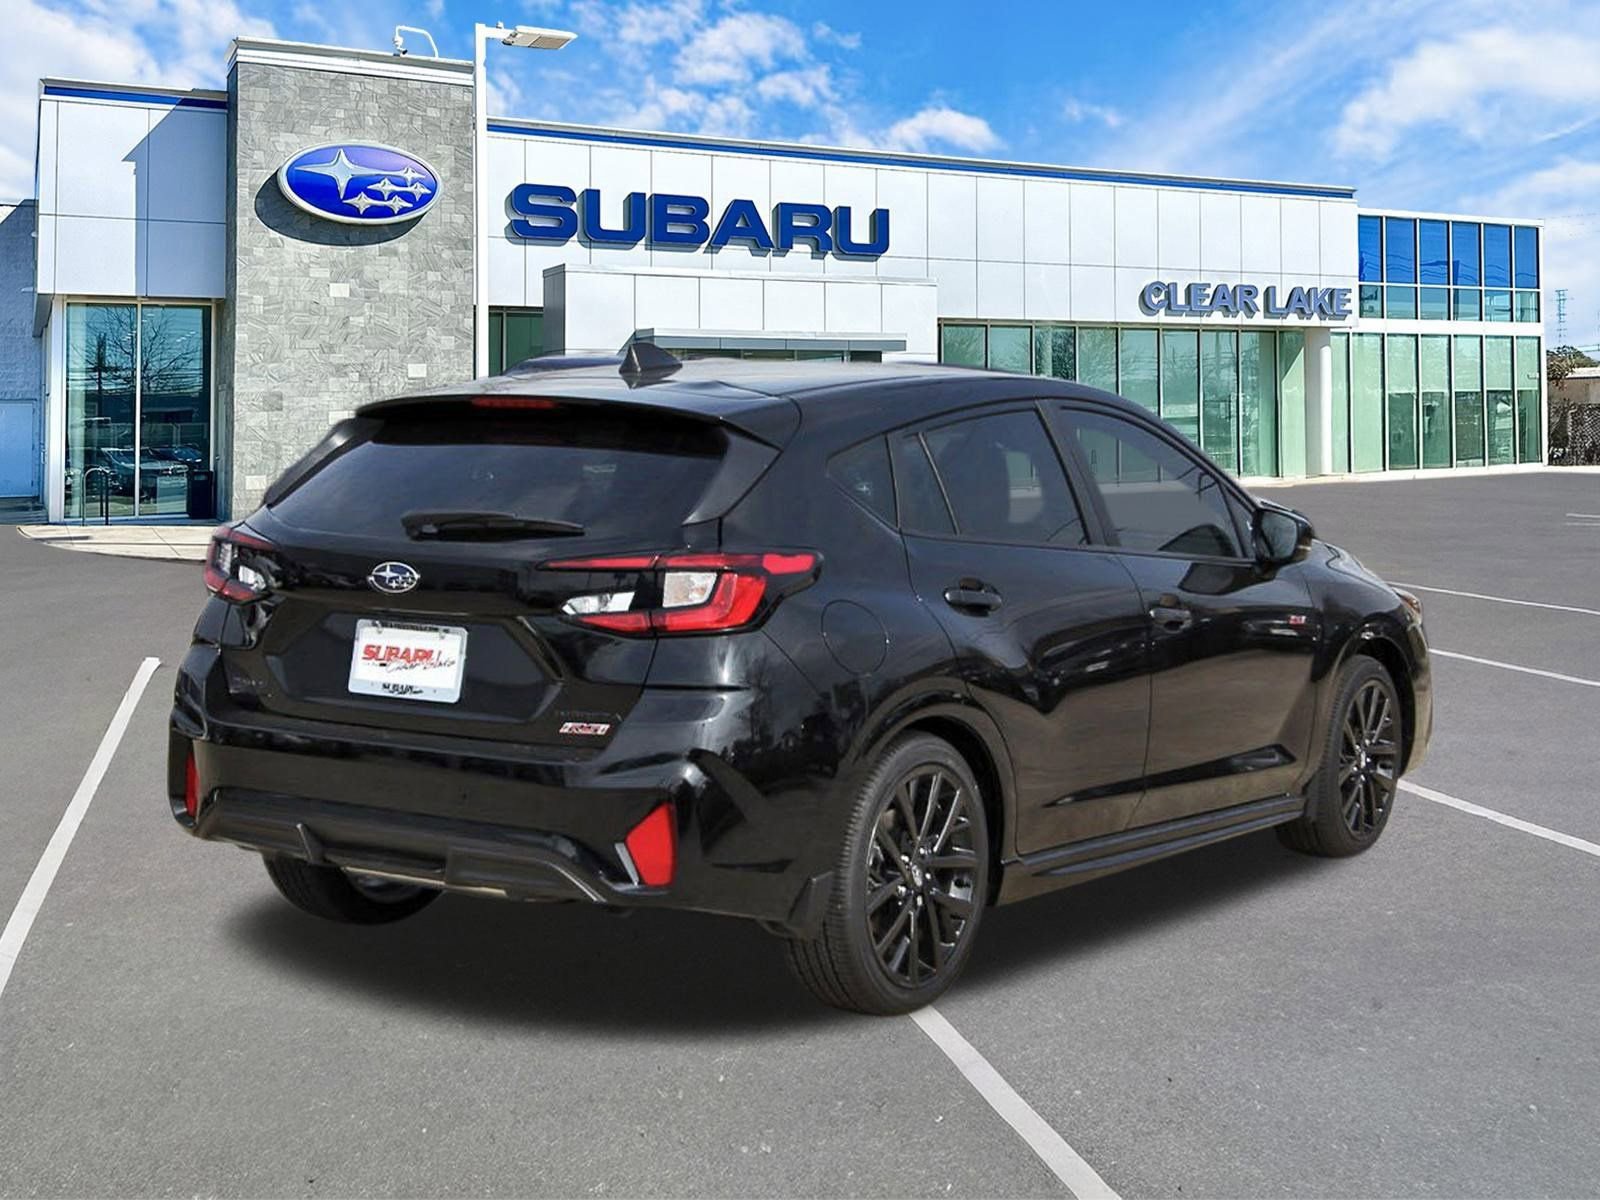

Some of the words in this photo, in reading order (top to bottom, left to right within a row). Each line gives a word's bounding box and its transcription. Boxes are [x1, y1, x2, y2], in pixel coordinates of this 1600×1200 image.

[505, 183, 890, 262] SUBARU
[1139, 280, 1260, 319] CLEAR
[1264, 285, 1352, 321] LAKE
